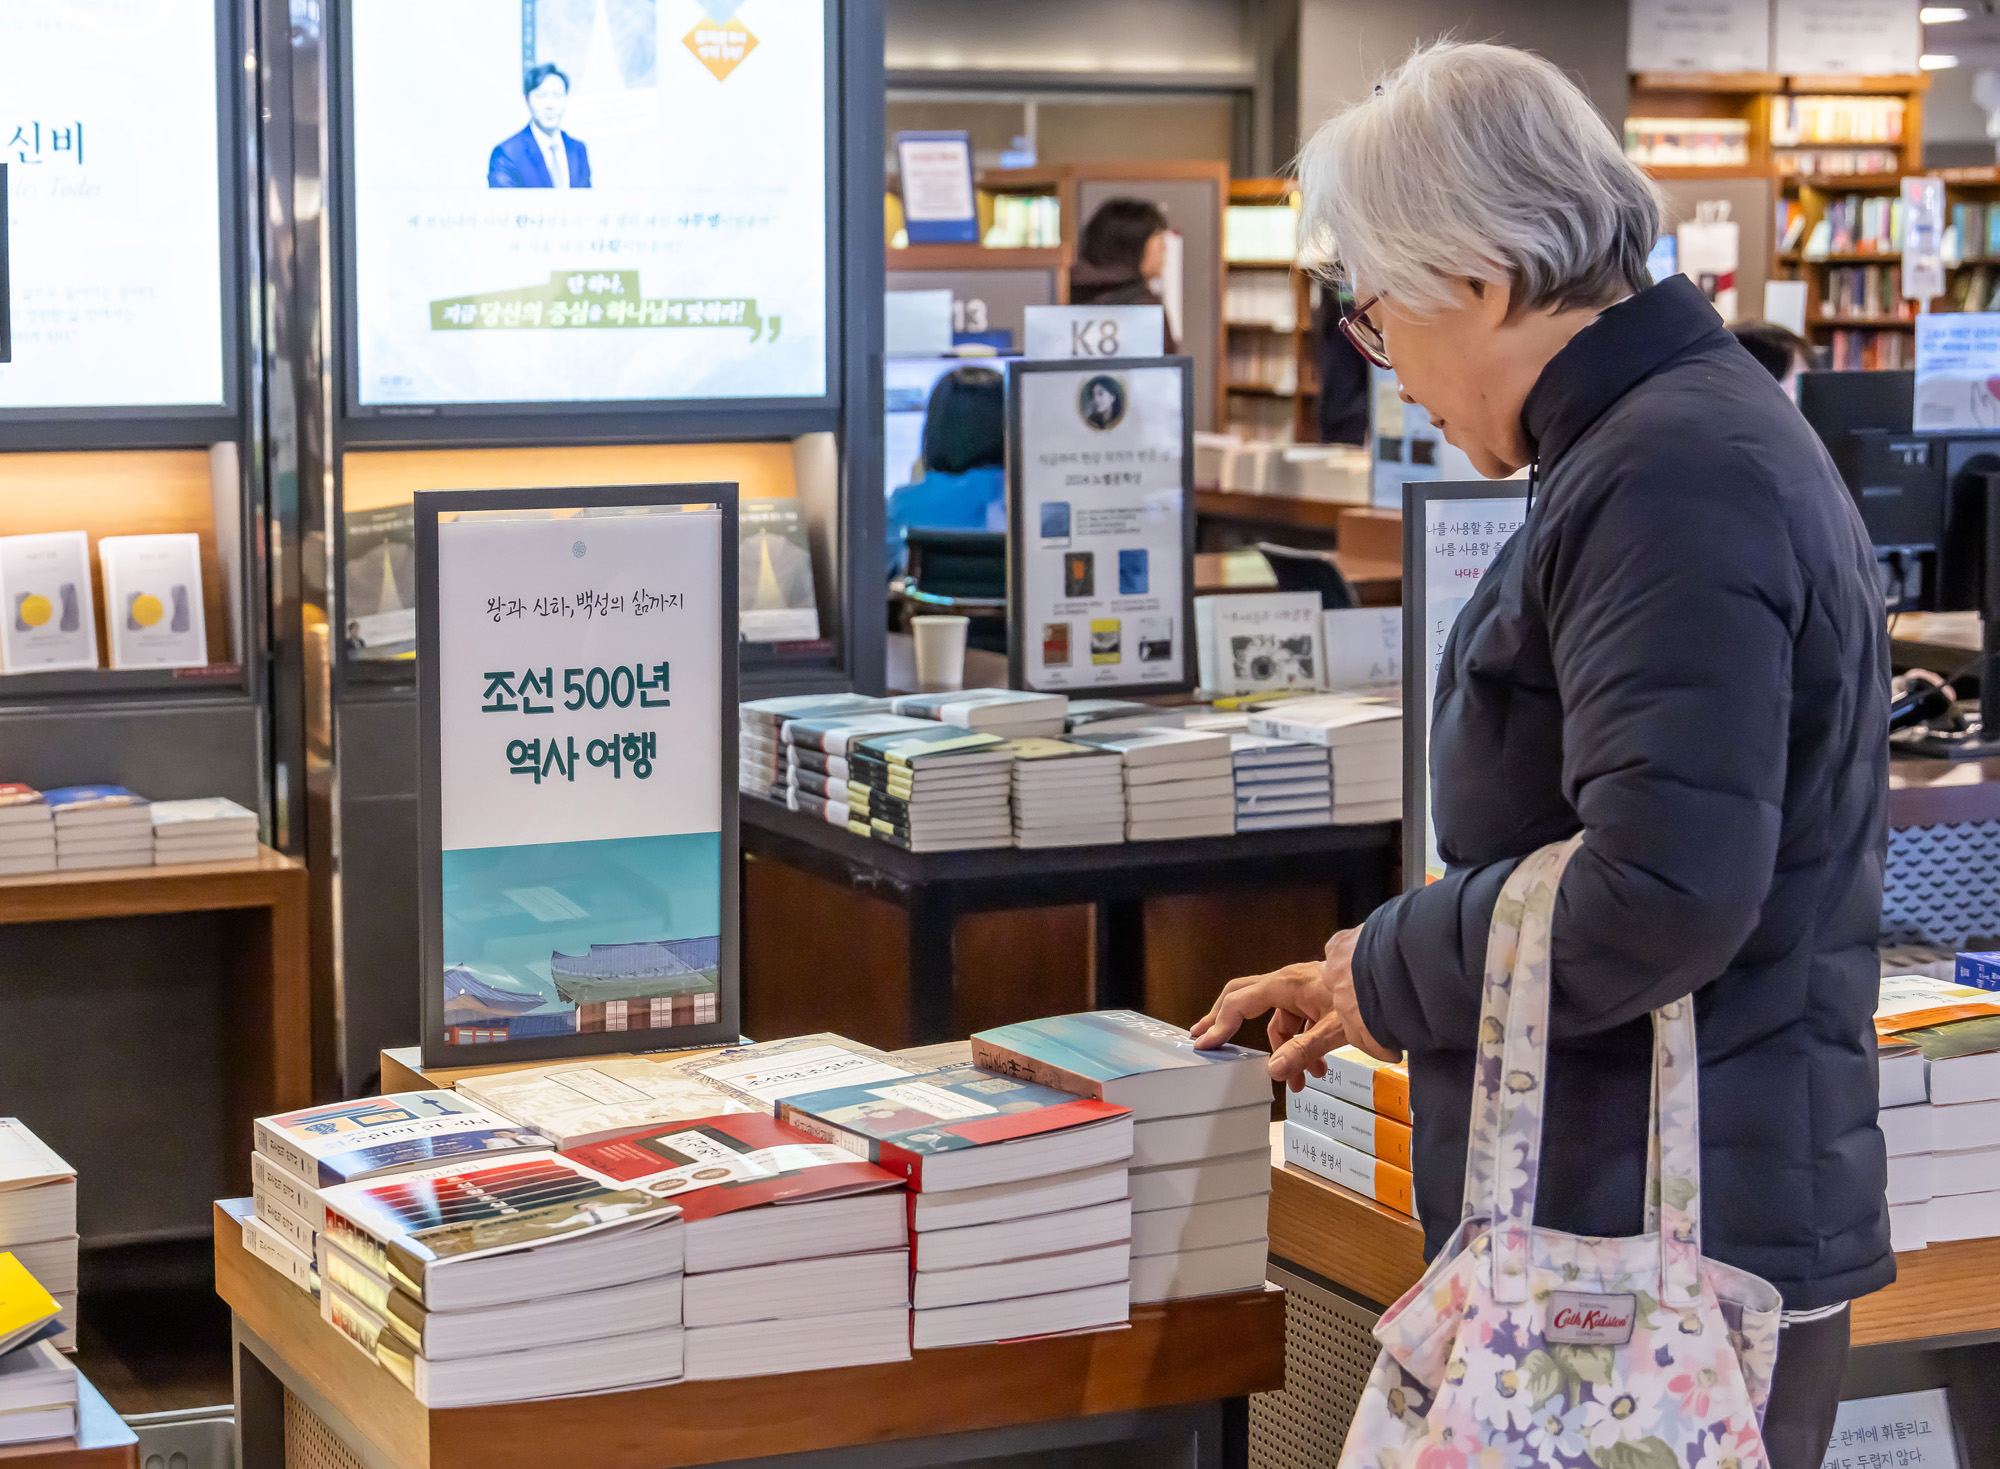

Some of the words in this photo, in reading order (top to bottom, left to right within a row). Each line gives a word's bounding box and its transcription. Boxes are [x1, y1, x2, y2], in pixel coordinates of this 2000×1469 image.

[7, 120, 84, 165] 신비
[1071, 320, 1120, 356] K8
[1450, 521, 1481, 536] 사용할
[1484, 521, 1495, 535] 줄
[1435, 543, 1456, 557] 나를
[1458, 542, 1490, 556] 사용할
[1454, 568, 1480, 579] 나다운
[487, 596, 527, 622] 왕과
[481, 667, 554, 714] 조선
[563, 661, 670, 711] 500년
[506, 736, 580, 784] 역사
[585, 731, 656, 780] 여행
[1294, 1099, 1302, 1113] 나
[1304, 1102, 1319, 1121] 사용
[1321, 1110, 1344, 1130] 설명서
[1292, 1139, 1299, 1153] 나
[1302, 1144, 1317, 1163] 사용
[1319, 1151, 1342, 1172] 설명서
[1840, 1425, 1878, 1447] 관계에
[1881, 1420, 1932, 1440] 휘둘리고
[1896, 1447, 1926, 1467] 않다.
